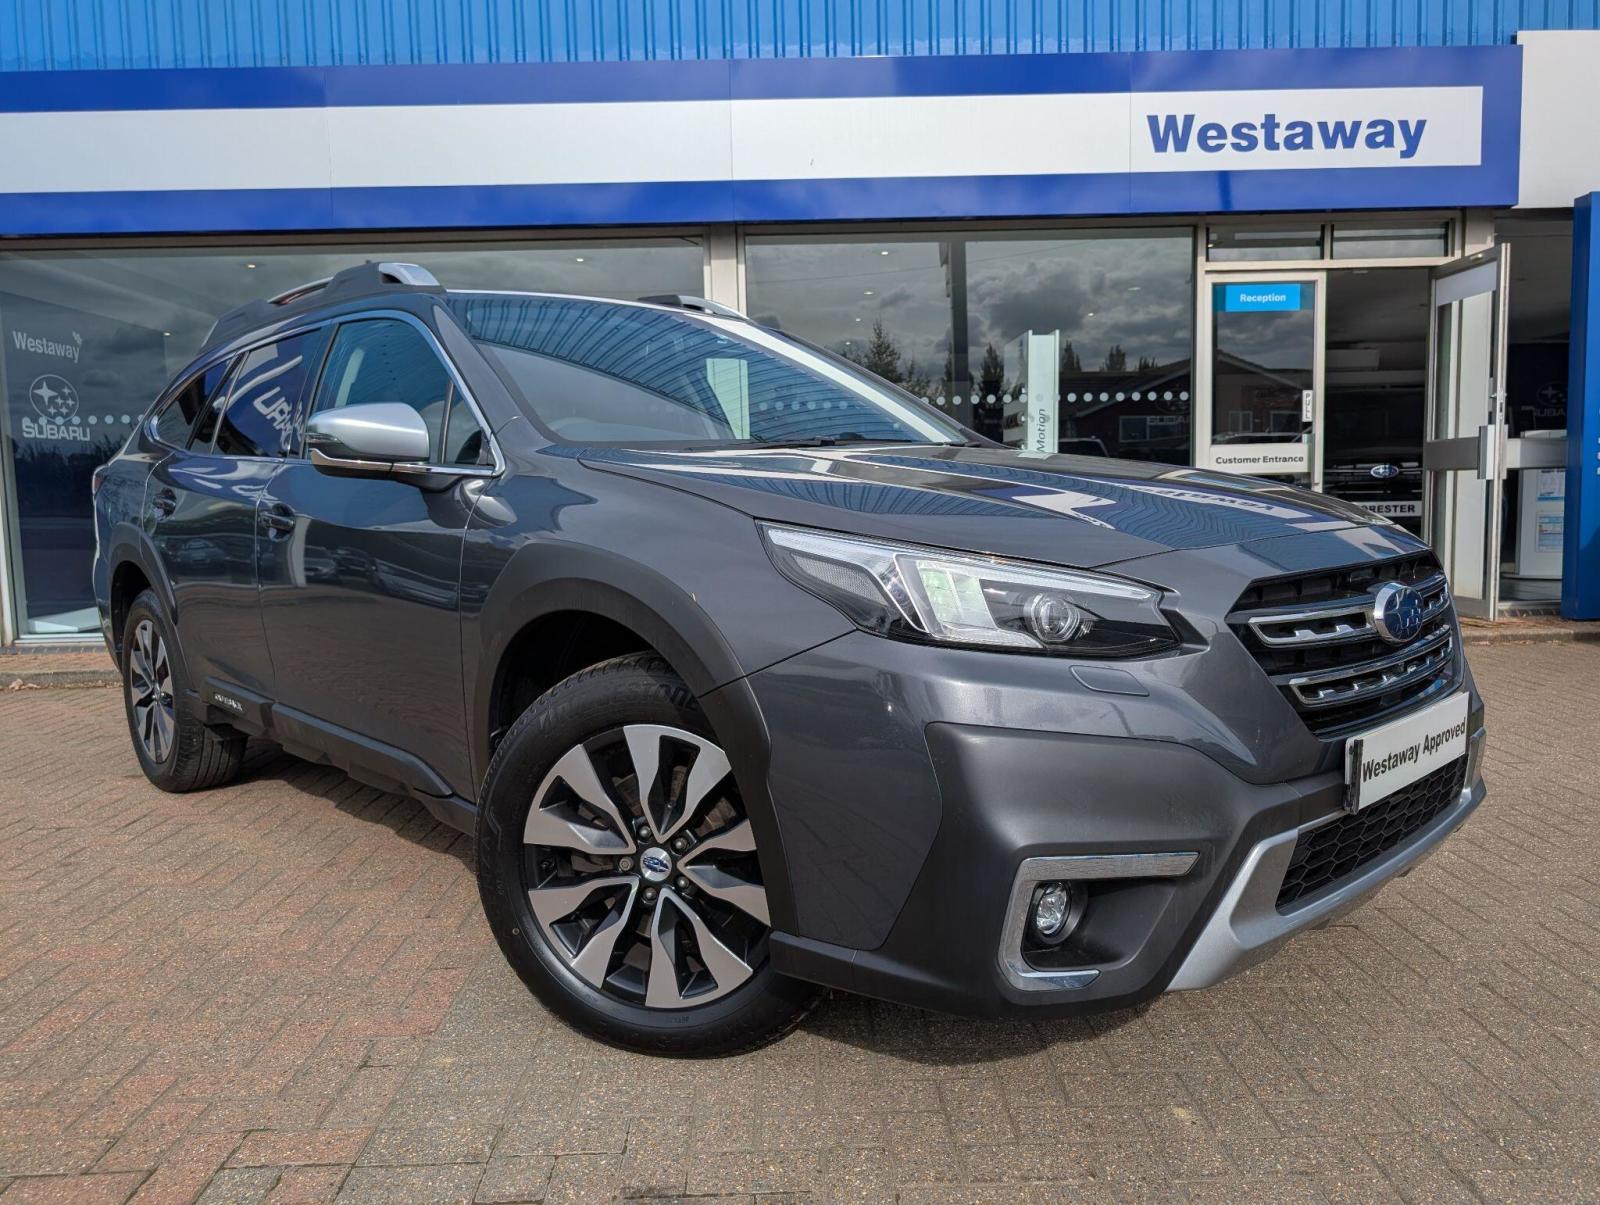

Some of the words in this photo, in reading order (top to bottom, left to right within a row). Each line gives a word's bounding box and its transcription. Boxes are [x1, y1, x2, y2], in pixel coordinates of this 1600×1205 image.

[1146, 113, 1427, 159] Westaway
[1239, 293, 1287, 304] Reception
[12, 330, 80, 364] Westaway
[22, 421, 91, 441] SUBARU
[1215, 455, 1261, 465] Customer
[1262, 455, 1304, 464] Entrance
[1361, 742, 1421, 783] Westaway
[1422, 716, 1466, 756] Approved
